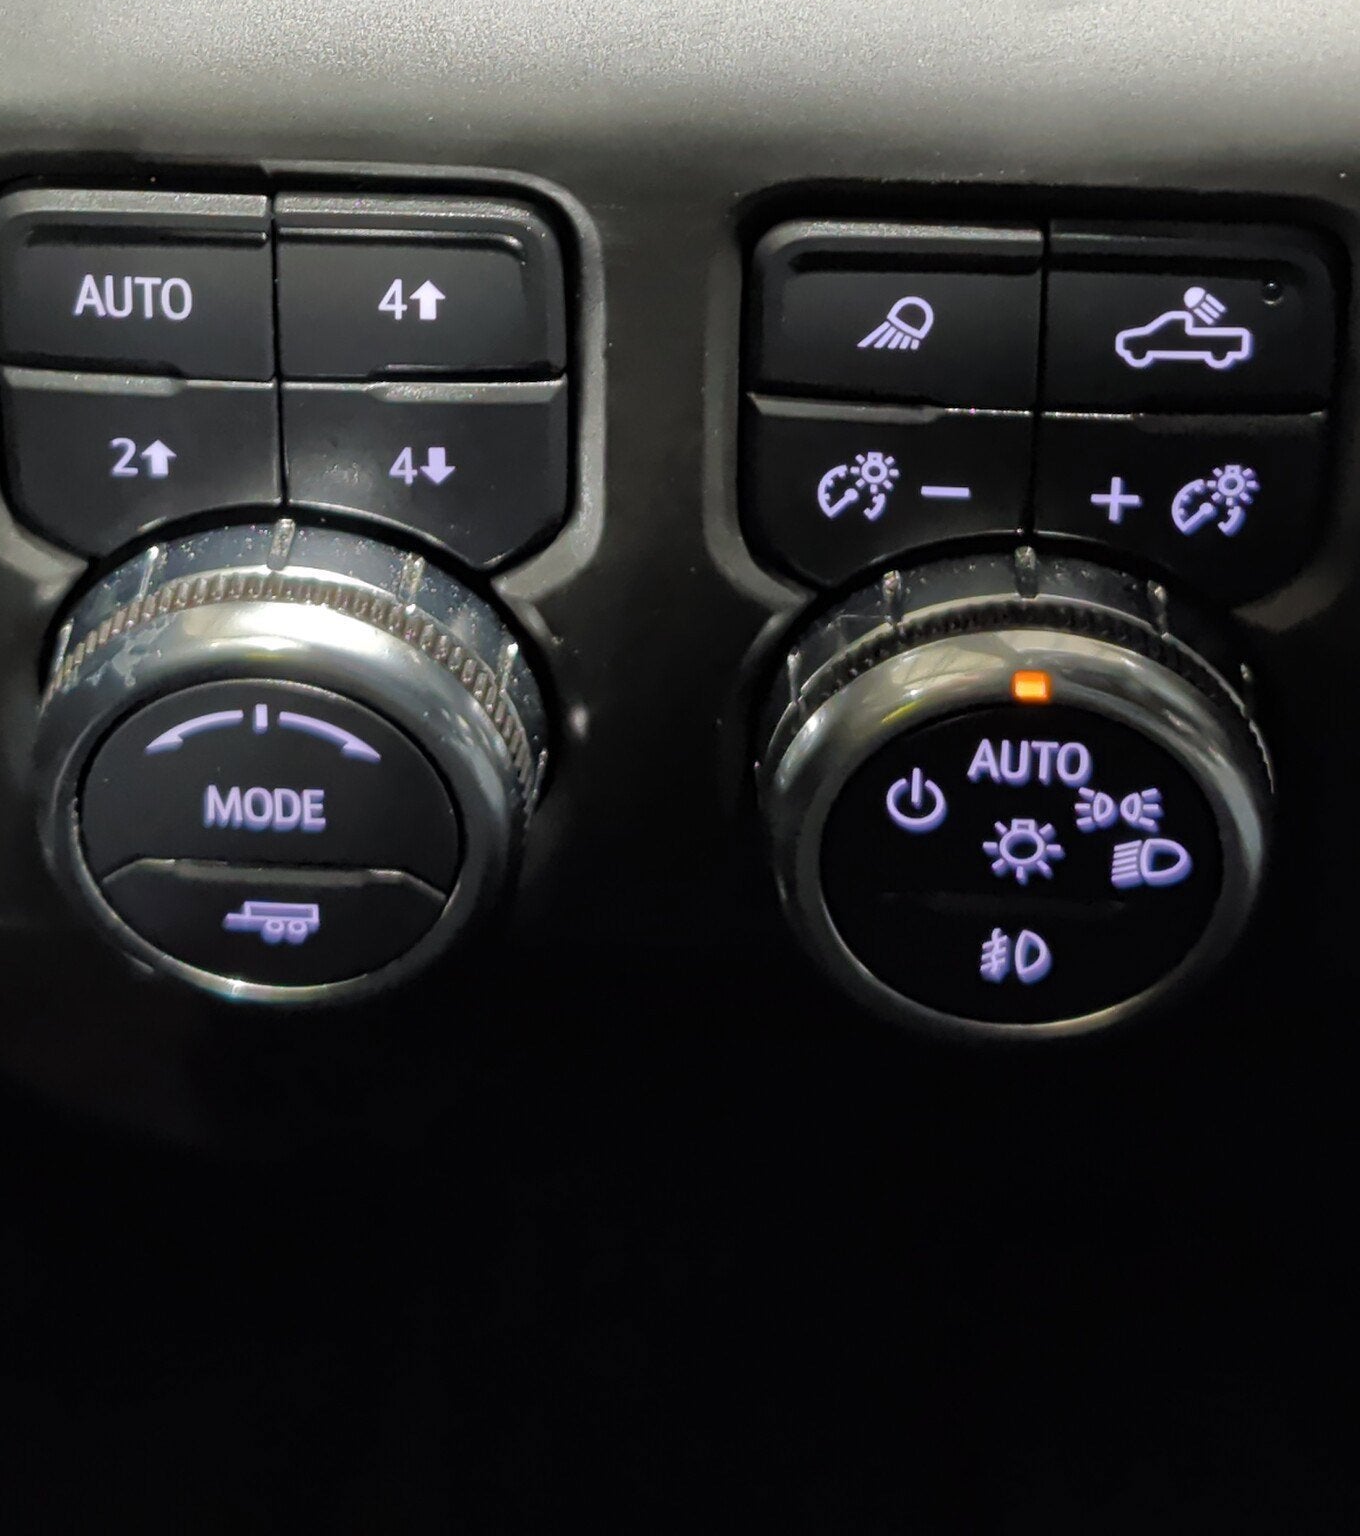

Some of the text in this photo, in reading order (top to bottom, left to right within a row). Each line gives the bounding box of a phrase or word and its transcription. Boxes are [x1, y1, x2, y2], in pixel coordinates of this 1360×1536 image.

[74, 273, 194, 322] AUTO
[966, 737, 1092, 787] AUTO
[204, 783, 328, 833] MODE
